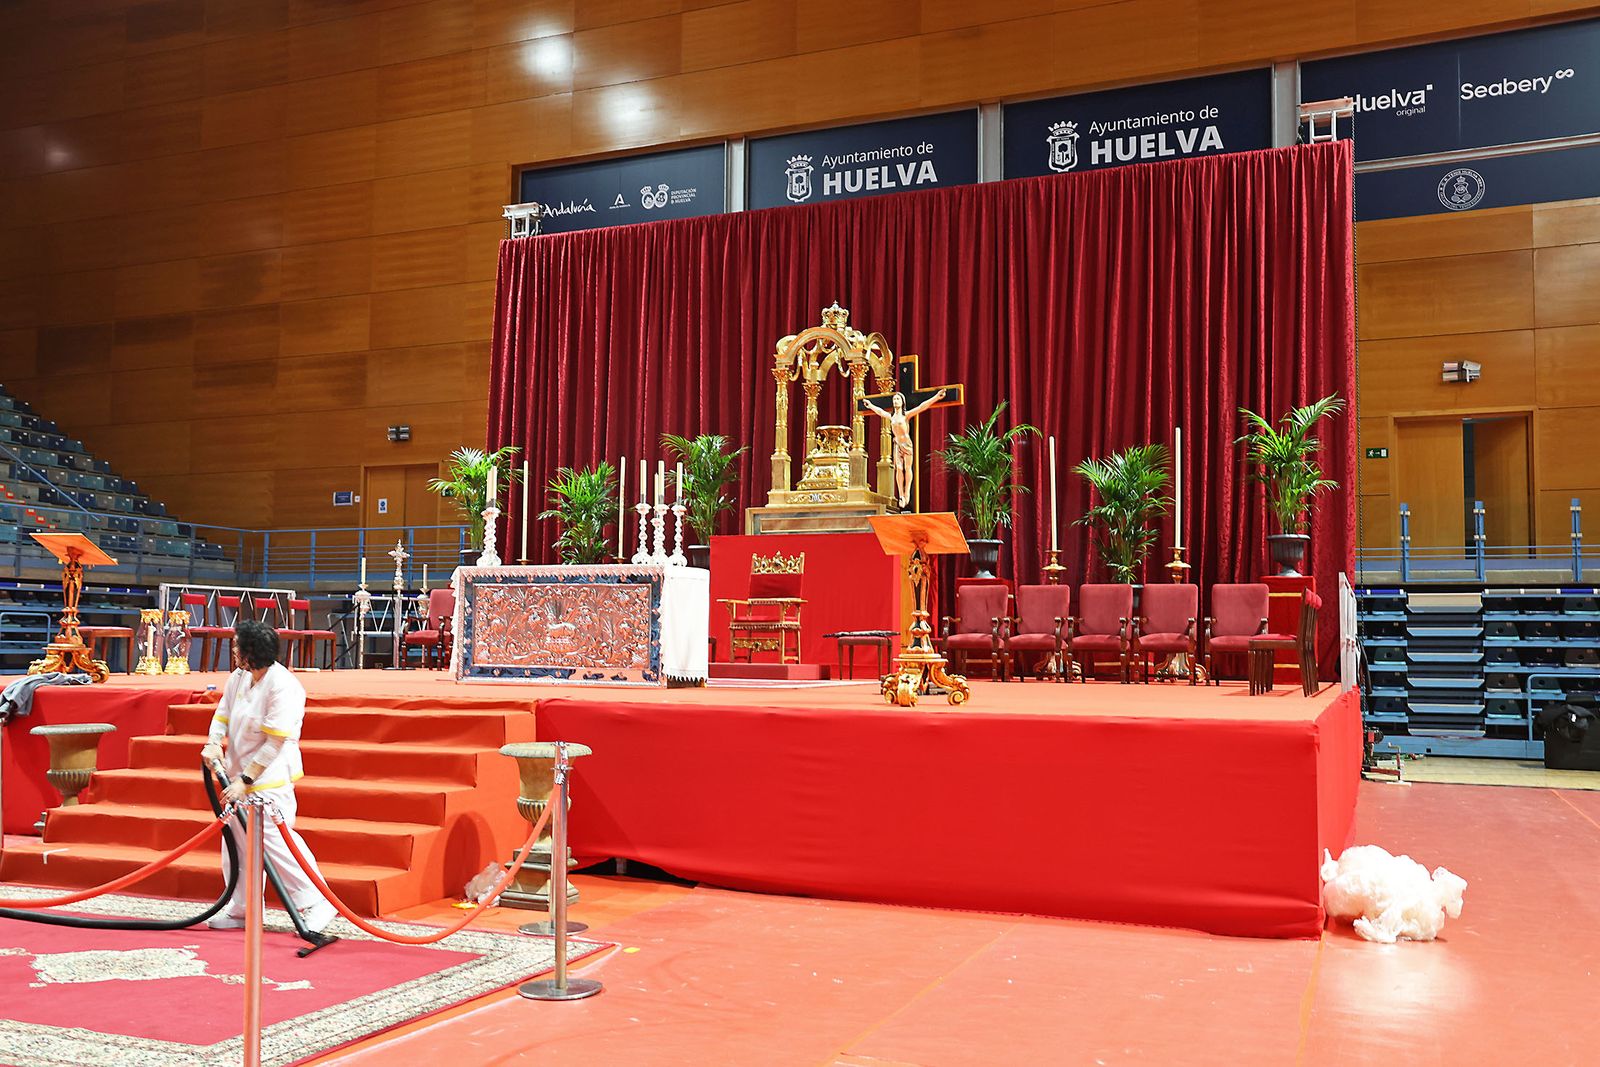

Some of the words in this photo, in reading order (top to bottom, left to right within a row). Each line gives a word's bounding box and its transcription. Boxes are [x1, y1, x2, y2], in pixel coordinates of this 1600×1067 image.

[1460, 75, 1553, 100] Seabery
[1088, 109, 1195, 137] Ayuntamiento
[1199, 105, 1219, 119] de
[1396, 105, 1426, 117] original
[821, 146, 913, 169] Ayuntamiento
[916, 141, 934, 154] de
[1090, 125, 1225, 165] HUELVA
[823, 160, 938, 195] HUELVA
